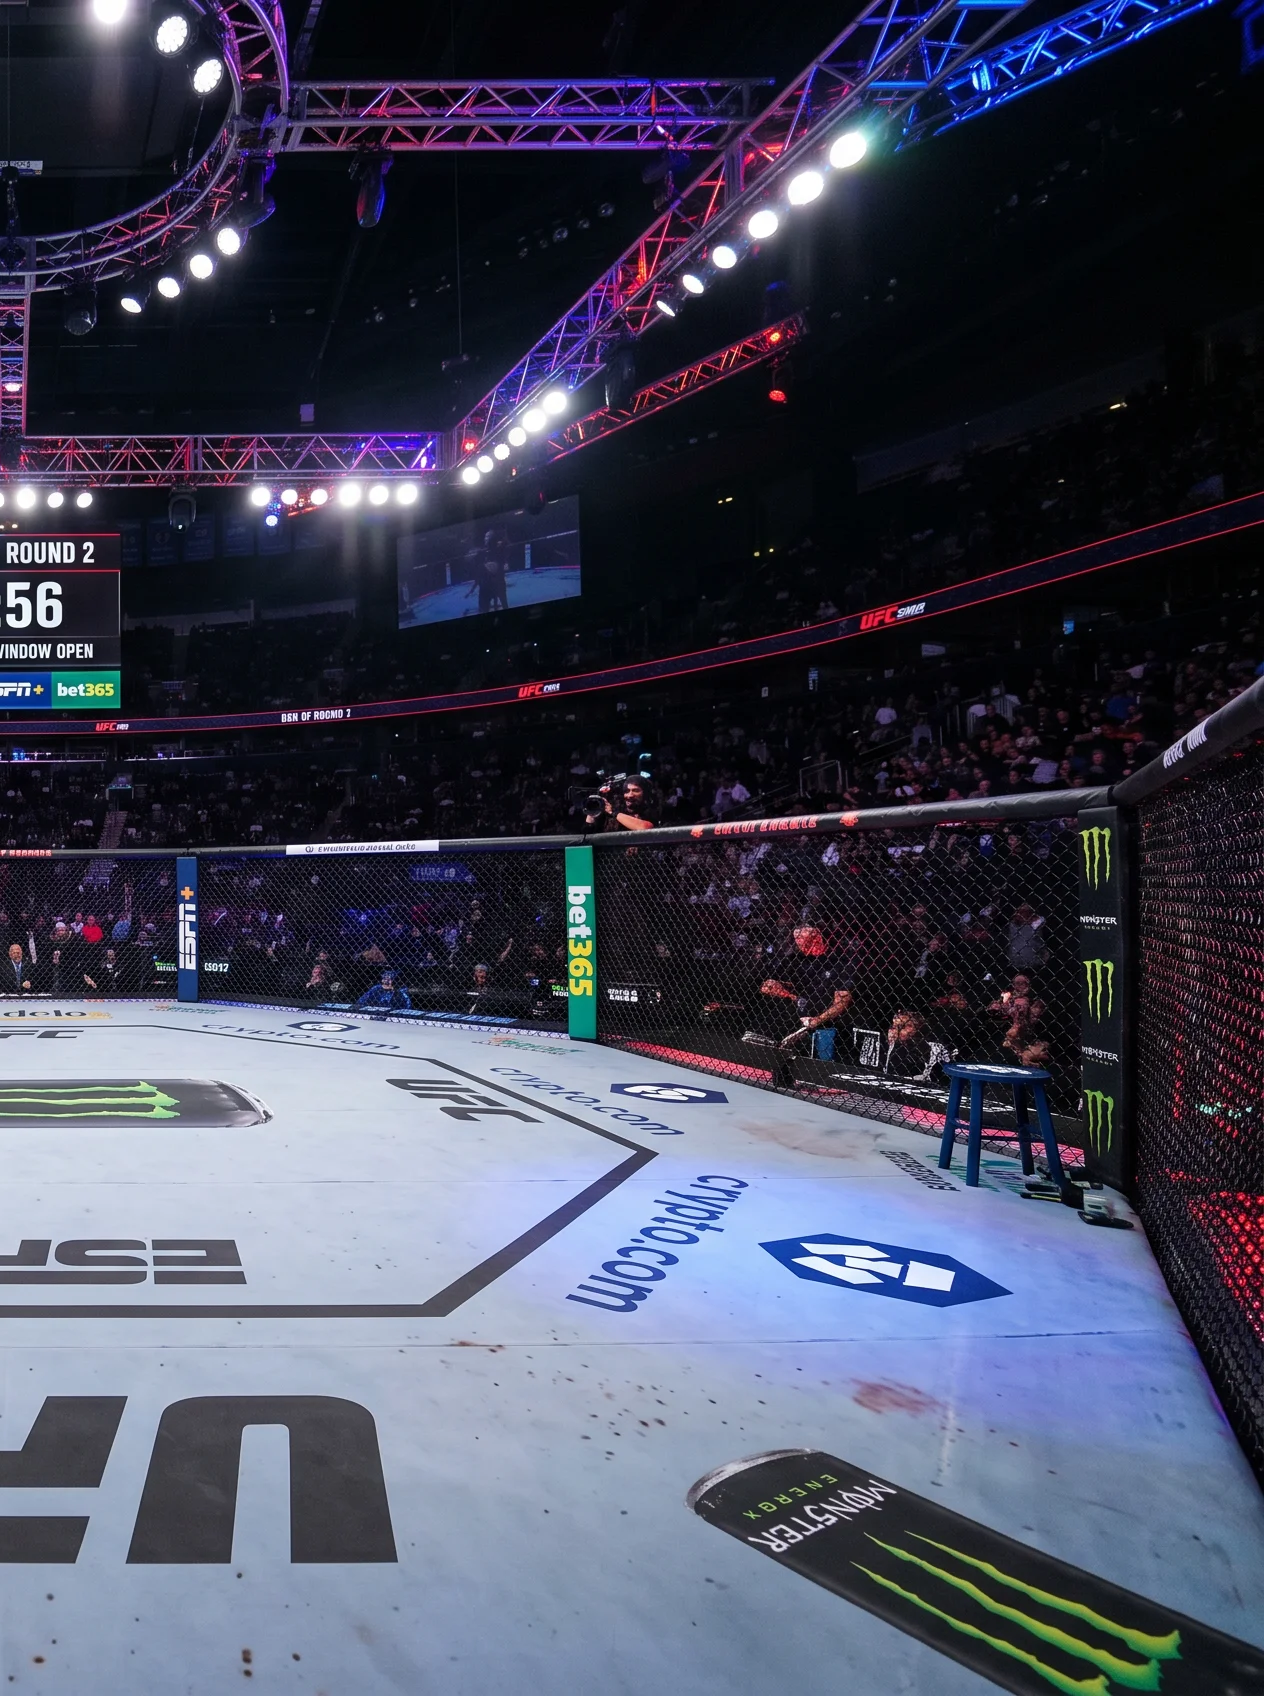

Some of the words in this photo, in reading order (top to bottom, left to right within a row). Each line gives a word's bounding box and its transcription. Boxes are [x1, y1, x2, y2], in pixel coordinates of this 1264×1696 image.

[6, 541, 76, 564] ROUND
[82, 541, 95, 564] 2
[859, 605, 899, 630] UFC
[56, 643, 94, 659] OPEN
[57, 682, 115, 697] bet365
[518, 683, 543, 698] UFC
[567, 885, 594, 997] bet365
[385, 1078, 545, 1124] UFC
[489, 1067, 685, 1136] crypto.com
[565, 1175, 749, 1313] crypto.com
